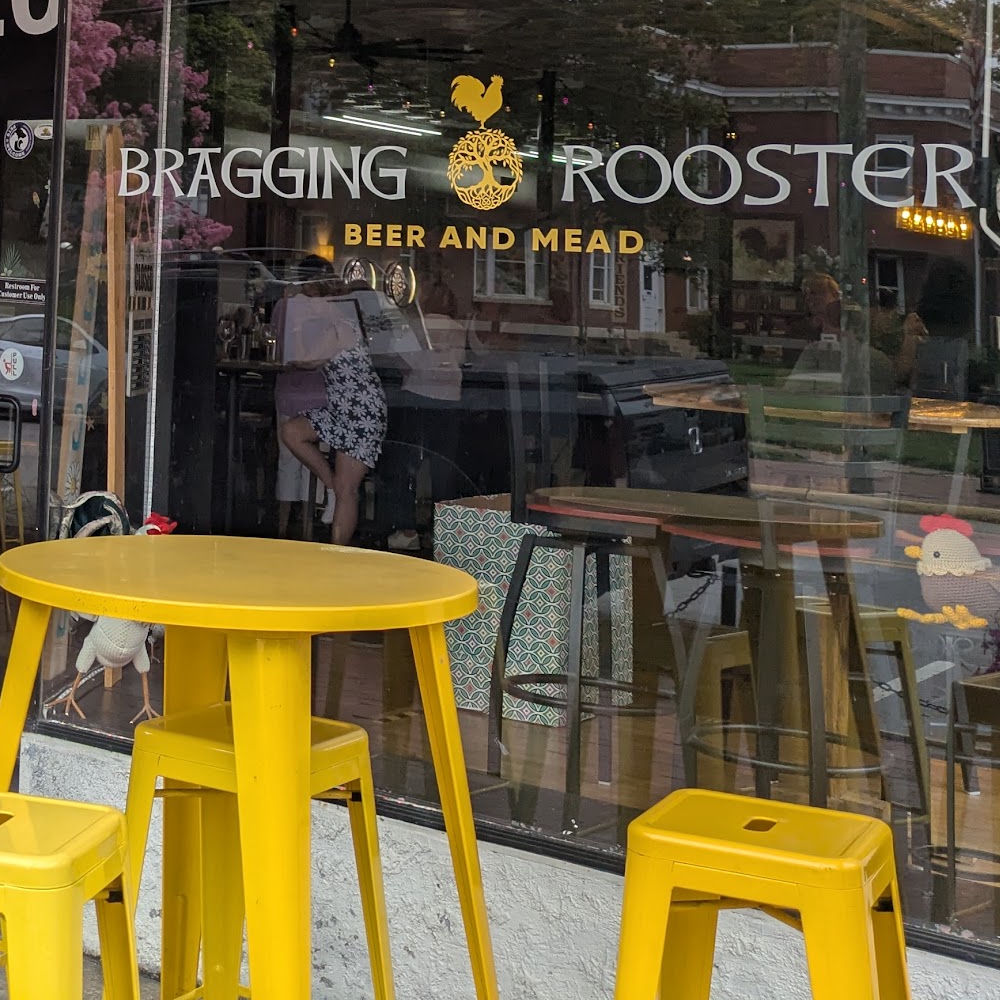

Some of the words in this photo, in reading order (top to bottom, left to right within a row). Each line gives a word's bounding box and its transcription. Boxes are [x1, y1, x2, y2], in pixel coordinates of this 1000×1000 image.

[118, 145, 408, 200] BRAGGING
[560, 143, 978, 209] ROOSTER
[344, 223, 426, 248] BEER
[439, 225, 516, 250] AND
[531, 228, 645, 254] MEAD
[4, 282, 30, 291] Restroom
[31, 284, 40, 292] For
[23, 291, 34, 300] Use
[34, 292, 46, 302] Only
